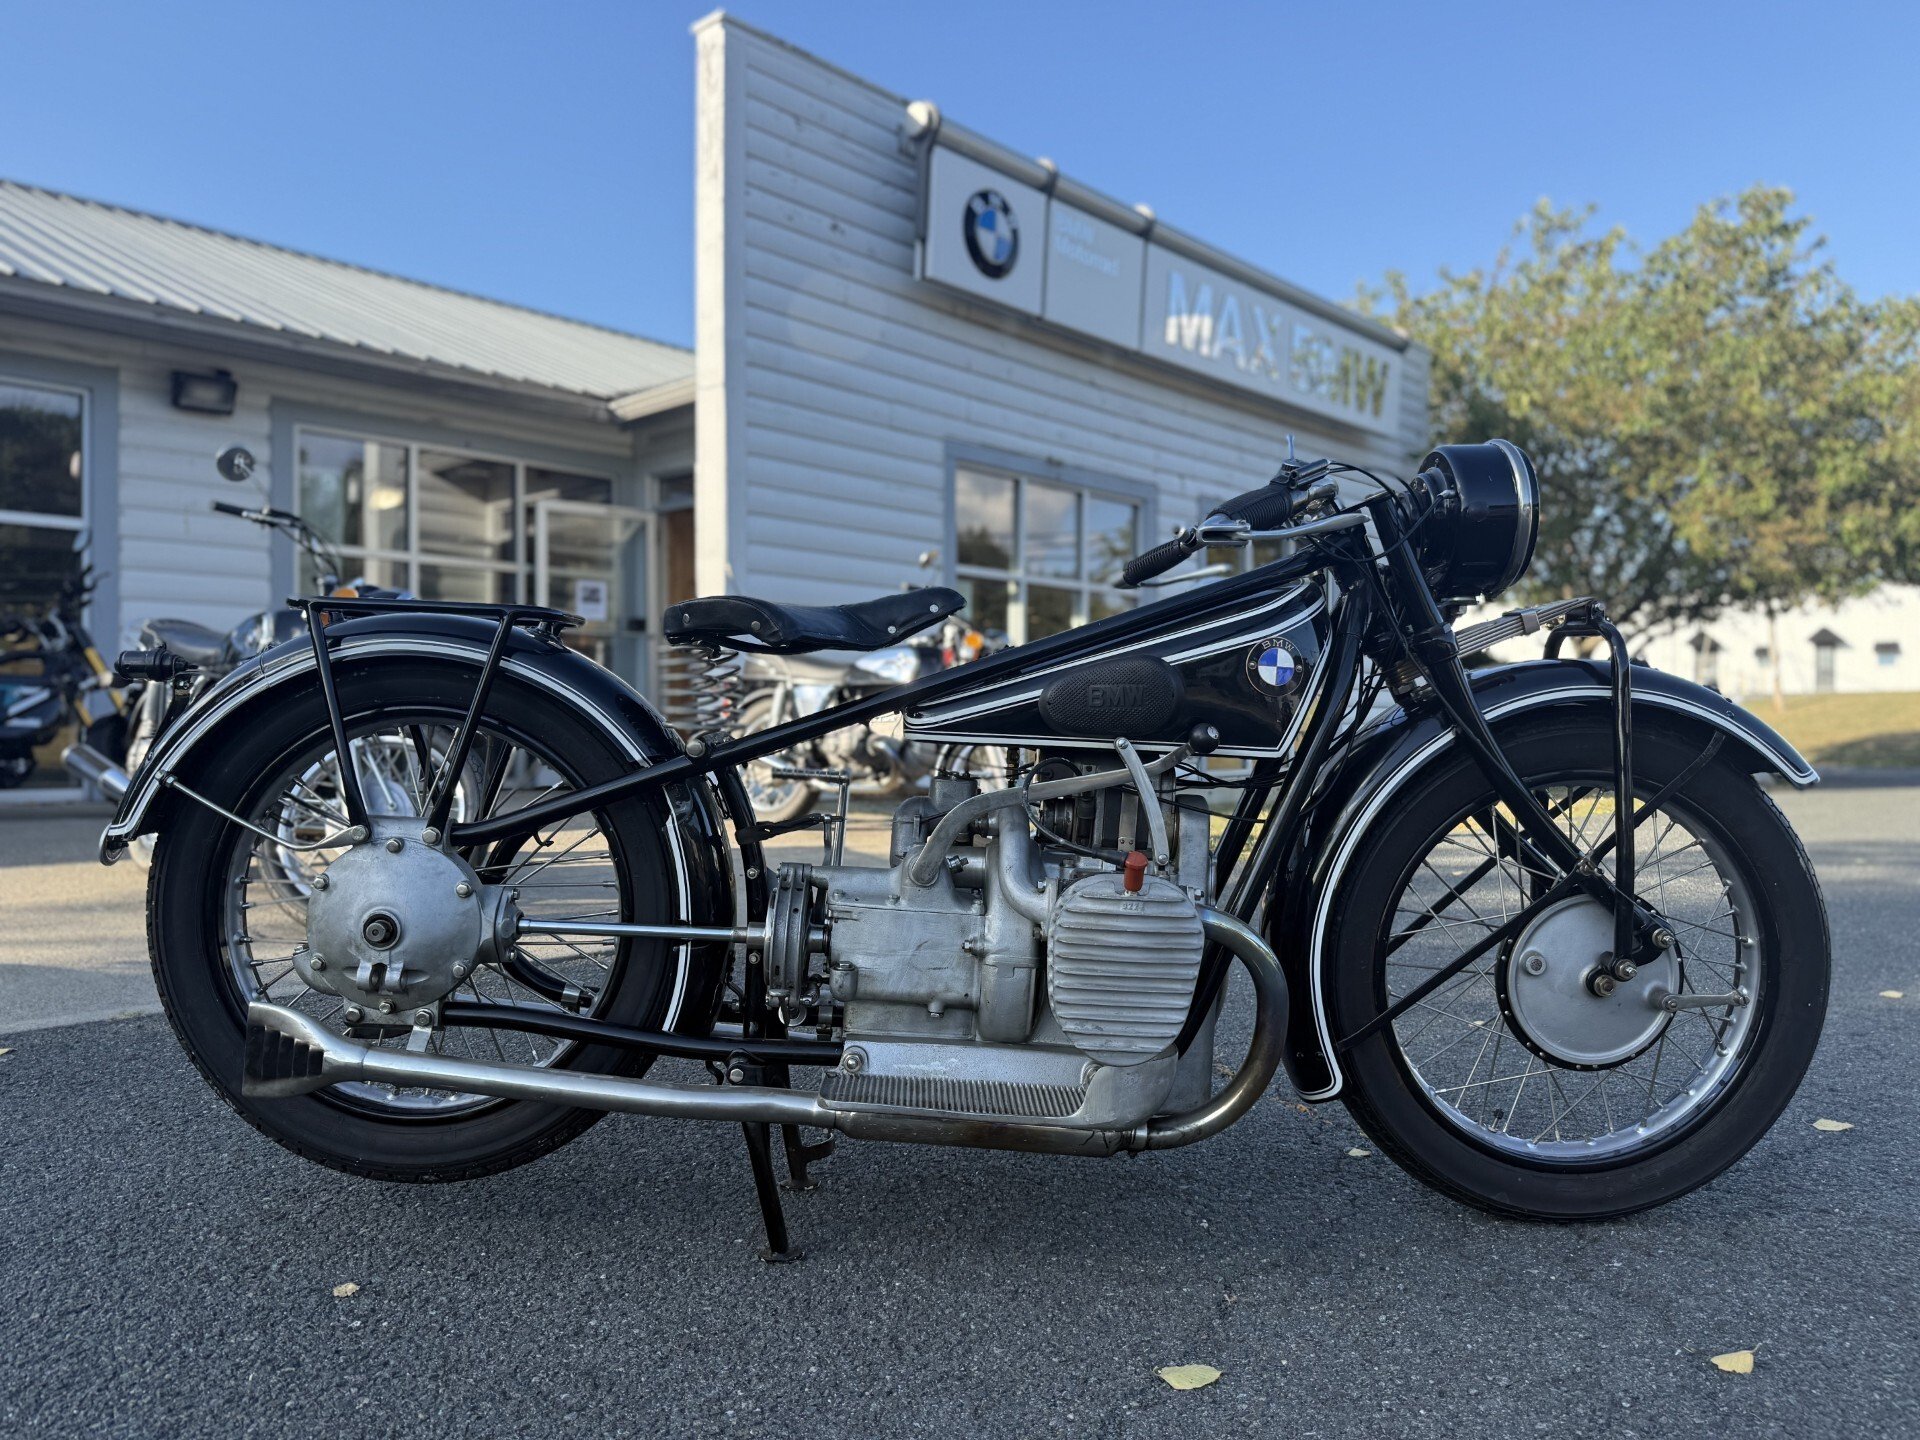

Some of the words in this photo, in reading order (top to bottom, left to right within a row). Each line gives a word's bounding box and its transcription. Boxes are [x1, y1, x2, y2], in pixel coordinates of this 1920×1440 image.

[1165, 270, 1281, 380] MAX
[1261, 639, 1295, 652] BMW
[1089, 685, 1145, 706] BMW
